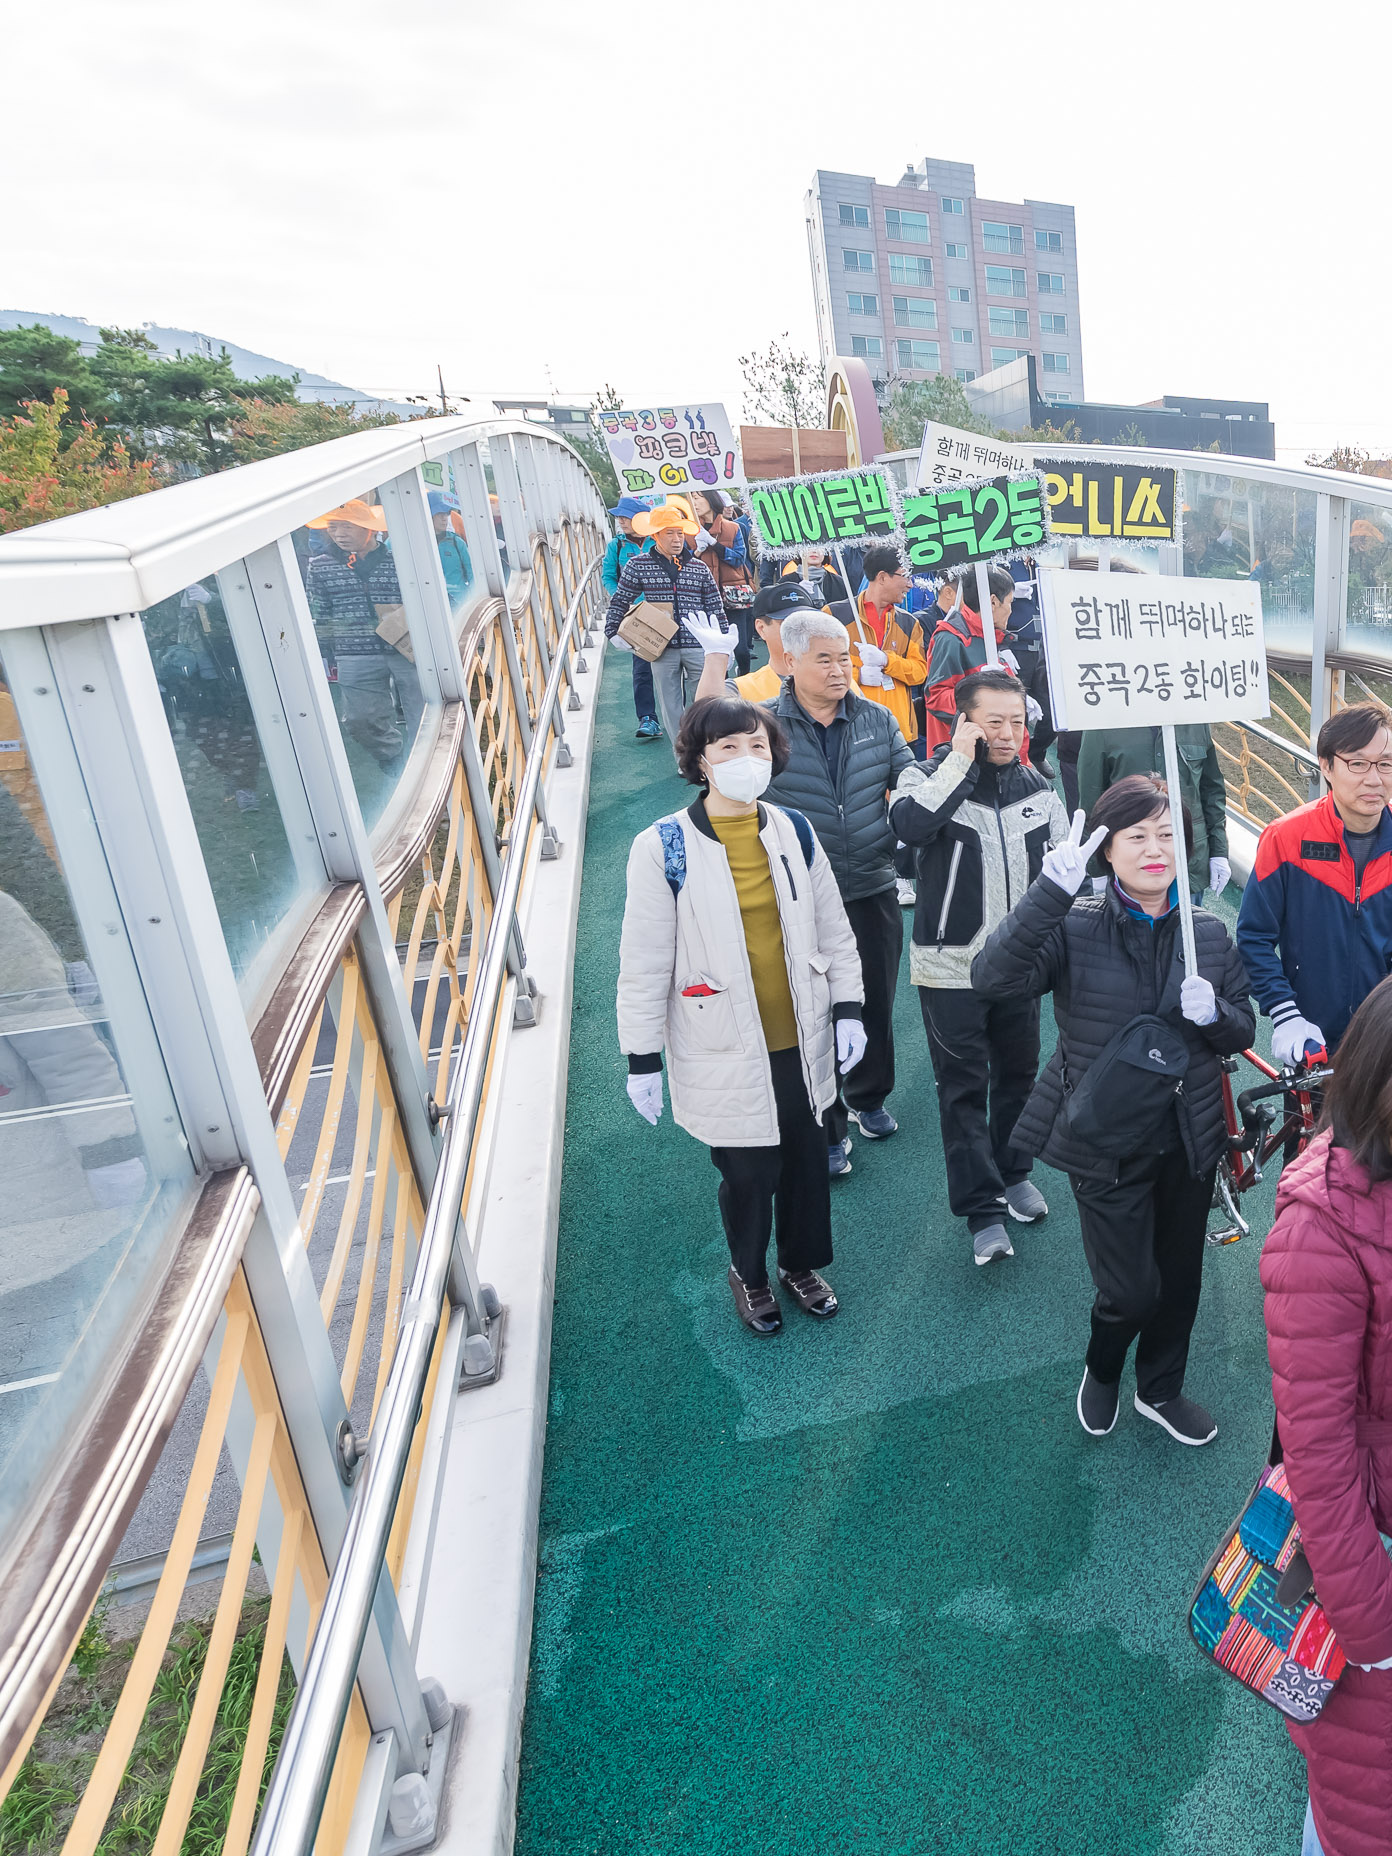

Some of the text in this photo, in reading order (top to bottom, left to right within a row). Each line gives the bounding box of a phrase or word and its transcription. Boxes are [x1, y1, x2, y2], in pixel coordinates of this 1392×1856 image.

[937, 436, 970, 462] 함께
[752, 474, 896, 546] 에어로빅
[904, 479, 1043, 566] 중곡2동
[1045, 472, 1172, 538] 언니쓰
[1070, 595, 1133, 640] 함께
[1139, 600, 1228, 639] 뛰며하나
[1078, 661, 1174, 707] 중곡2동
